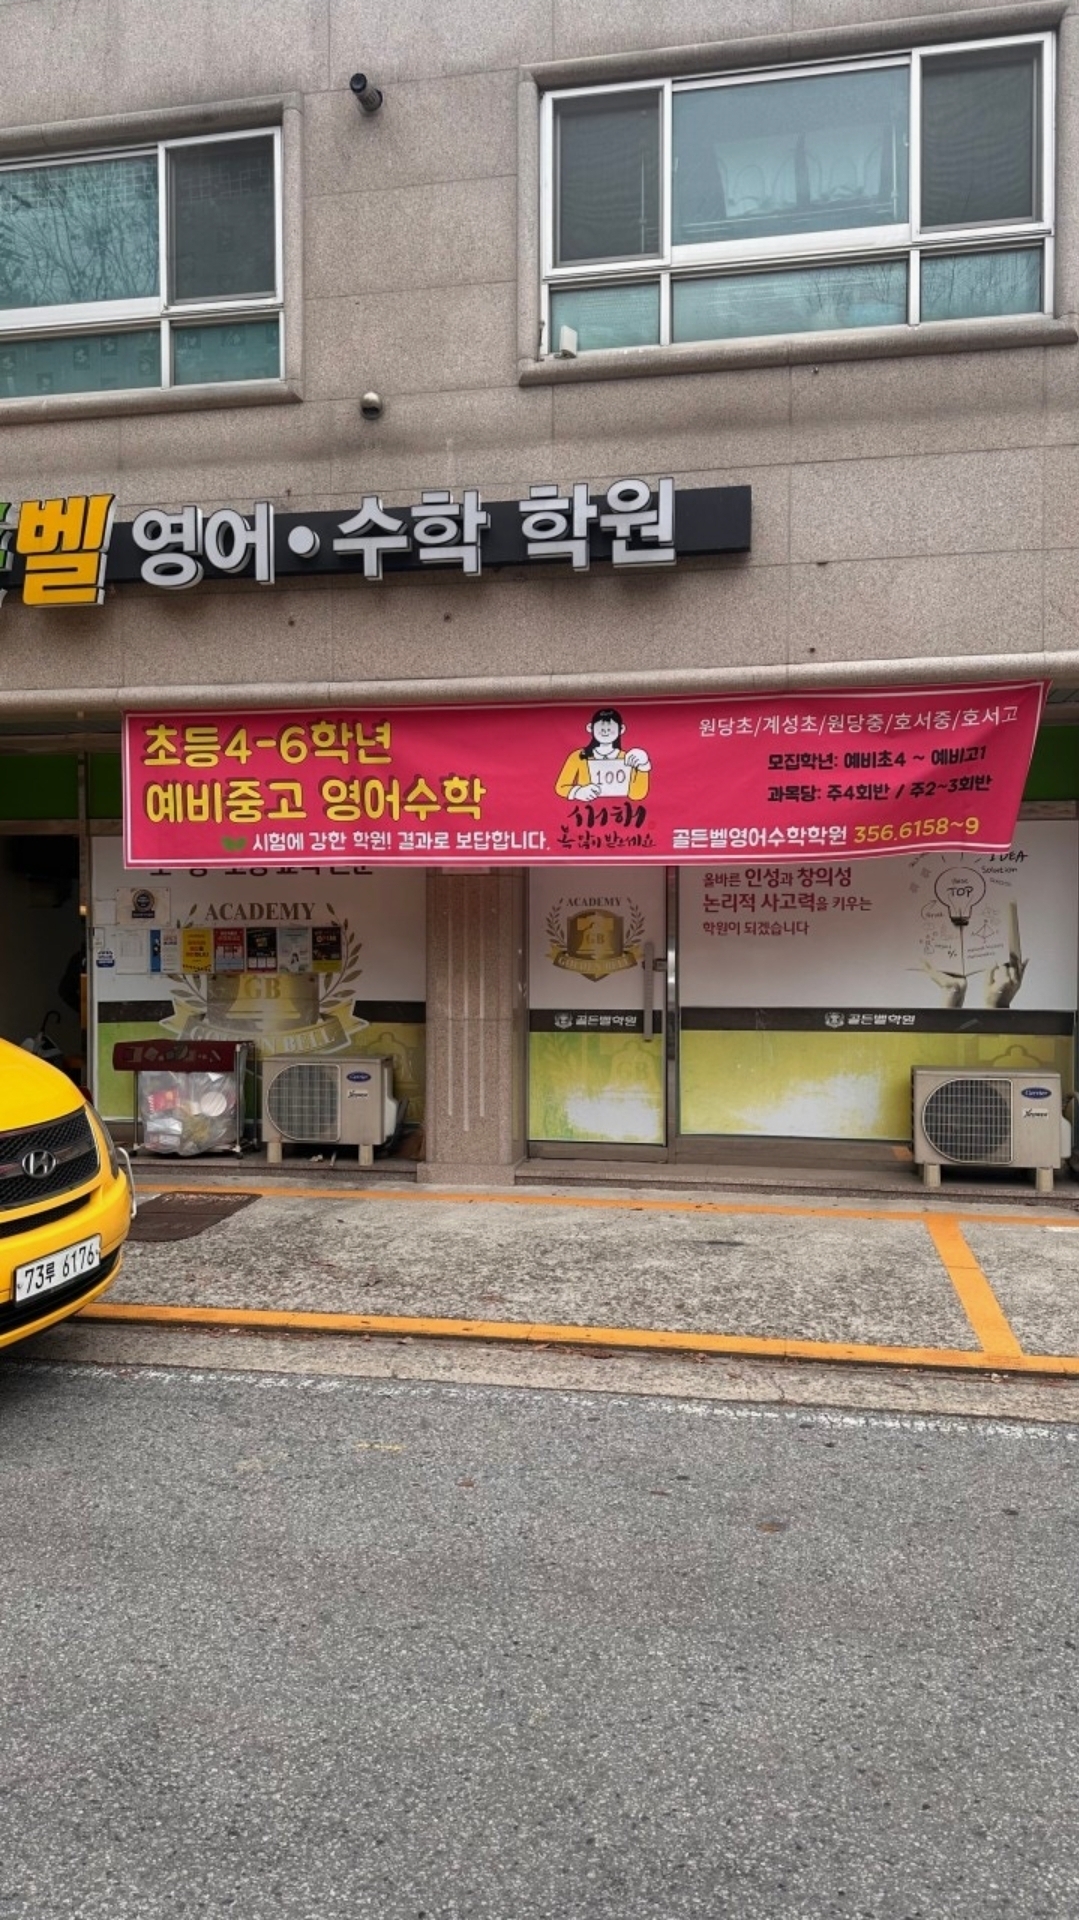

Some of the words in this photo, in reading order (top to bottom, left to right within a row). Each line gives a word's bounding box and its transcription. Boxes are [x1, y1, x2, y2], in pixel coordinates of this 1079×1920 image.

[0, 493, 116, 607] 벨
[521, 477, 676, 571] 학원
[144, 721, 392, 767] 초등4-6학년
[768, 752, 838, 770] 모집학년:
[844, 749, 906, 769] 예비초4
[931, 745, 986, 766] 예비고1
[596, 769, 626, 785] 100
[146, 777, 307, 823] 예비중고
[322, 776, 487, 821] 영어수학
[767, 786, 821, 803] 과목당:
[827, 783, 890, 801] 주4회반
[910, 775, 992, 798] 주2~3회반
[567, 802, 647, 828] 새해
[253, 832, 304, 851] 시험에
[309, 831, 347, 851] 강한
[353, 831, 391, 850] 학원!
[398, 831, 450, 850] 결과로
[456, 831, 550, 850] 보답합니다.
[672, 826, 846, 848] 골든벨영어수학학원
[853, 817, 979, 843] 356.6158~9
[703, 873, 741, 888] 올바른
[745, 868, 794, 888] 인성과
[798, 867, 851, 887] 창의성
[566, 897, 622, 907] ACADEMY
[703, 893, 755, 913] 논리적
[761, 893, 828, 912] 사고력을
[832, 896, 873, 911] 키우는
[946, 886, 974, 898] TOP
[205, 902, 316, 921] ACADEMY
[703, 921, 741, 935] 학원이
[744, 921, 809, 936] 되겠습니다
[245, 977, 281, 999] GB
[848, 1013, 916, 1026] 골든벨학원
[284, 1027, 336, 1053] BELL
[24, 1261, 55, 1294] 73루
[62, 1243, 95, 1278] 6176
